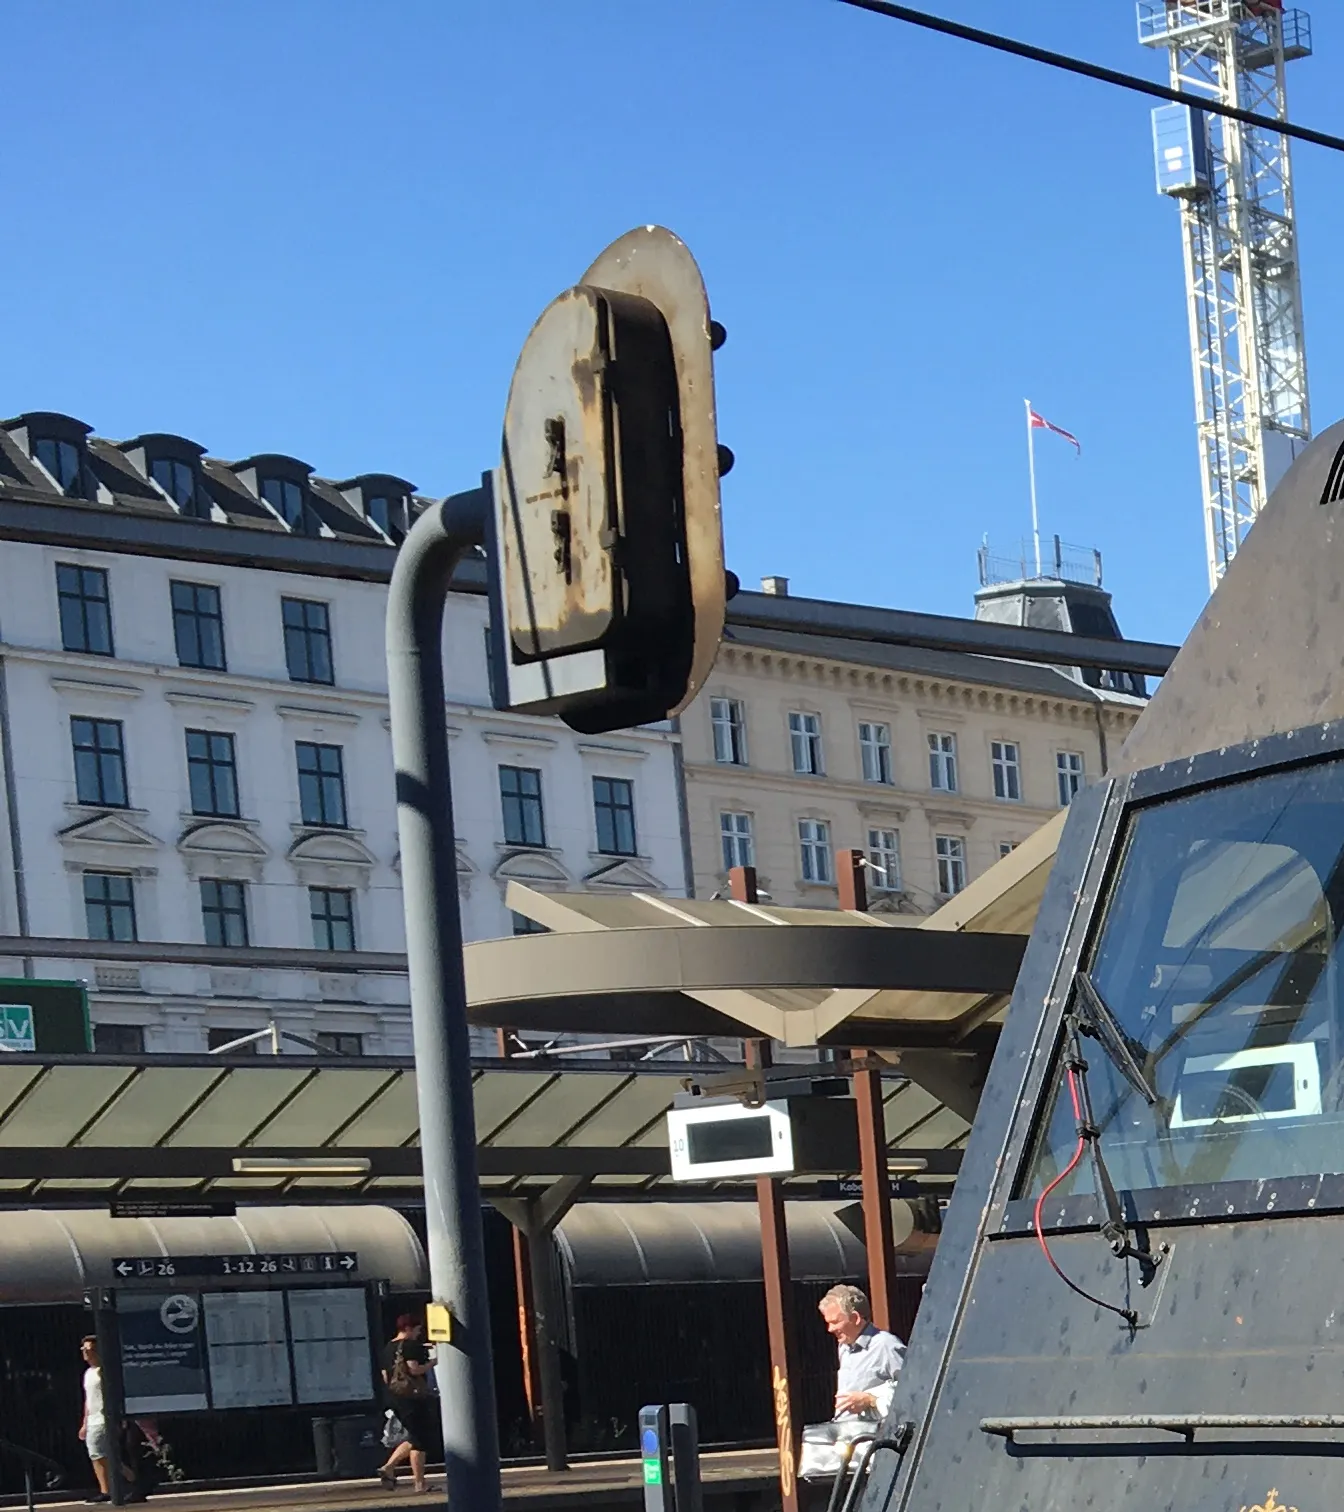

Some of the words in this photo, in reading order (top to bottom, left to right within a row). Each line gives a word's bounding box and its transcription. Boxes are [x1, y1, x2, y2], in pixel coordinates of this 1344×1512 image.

[158, 1263, 175, 1275] 26
[223, 1261, 254, 1273] 1-12
[260, 1260, 277, 1272] 26
